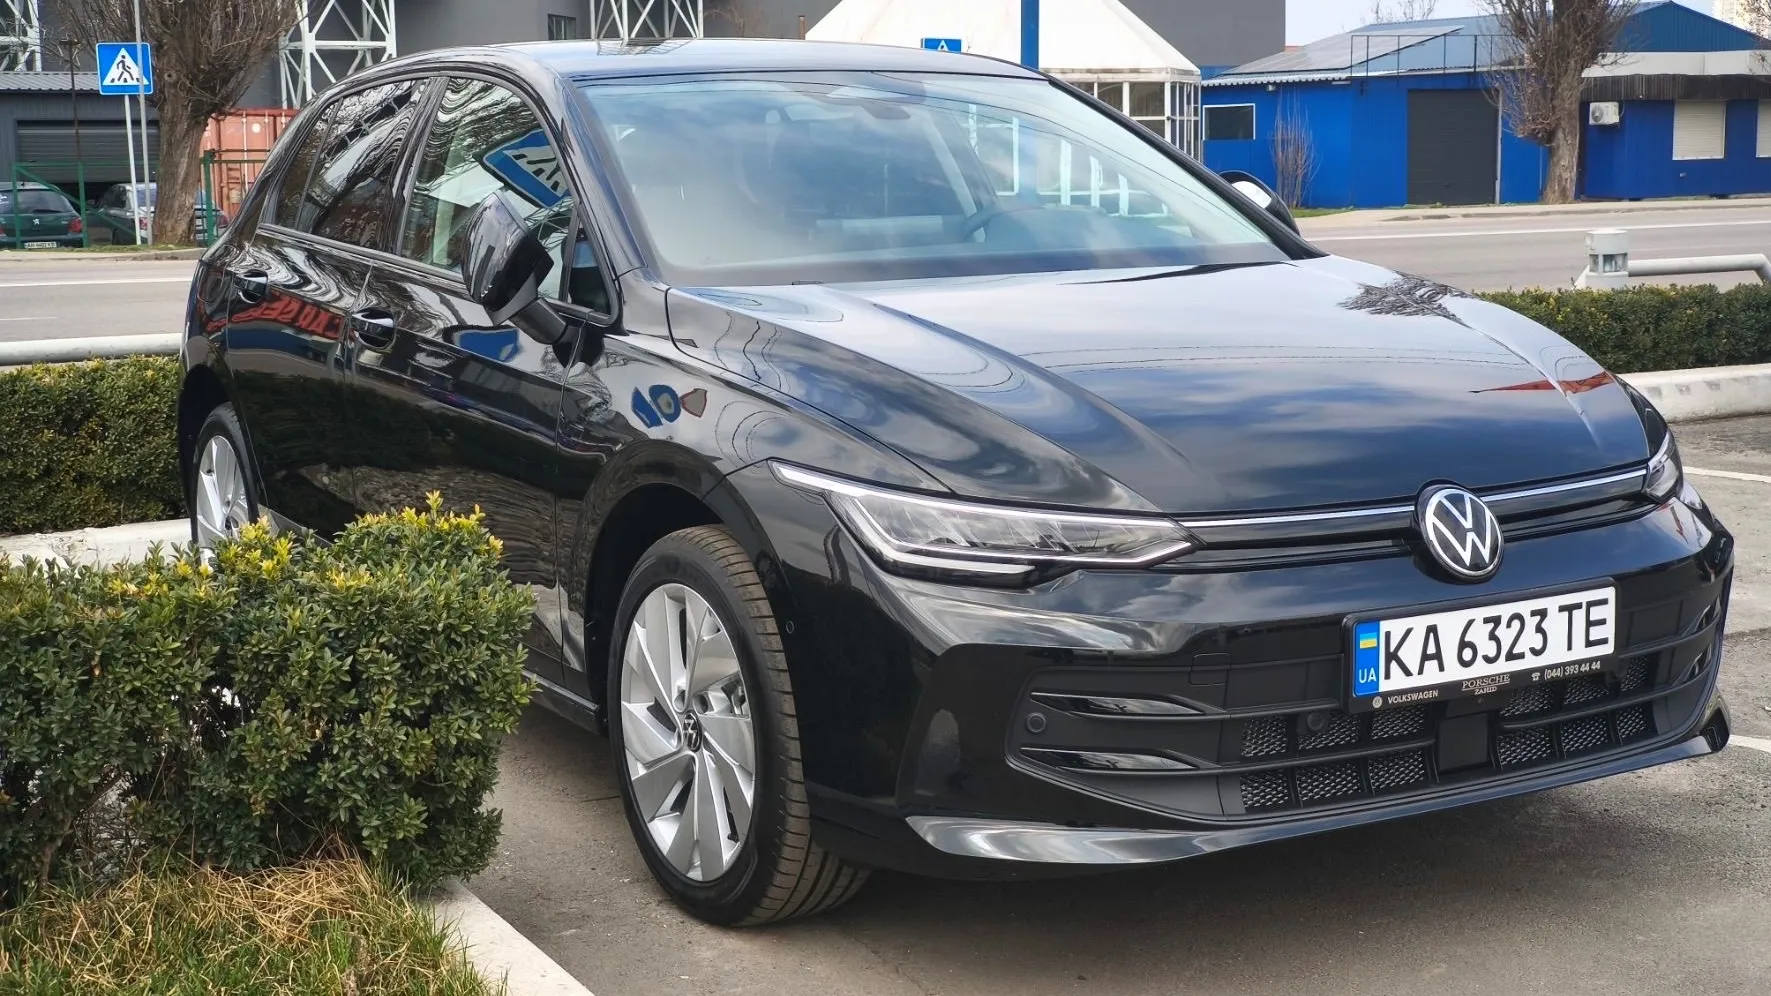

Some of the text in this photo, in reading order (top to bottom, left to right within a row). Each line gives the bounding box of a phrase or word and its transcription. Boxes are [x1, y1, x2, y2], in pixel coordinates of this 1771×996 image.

[1383, 597, 1610, 681] KA 6323 TE
[1358, 666, 1378, 684] UA
[1544, 660, 1601, 681] (044) 393 44 44
[1461, 673, 1512, 690] PORSCHE
[1387, 689, 1440, 705] VOLKSWAGEN
